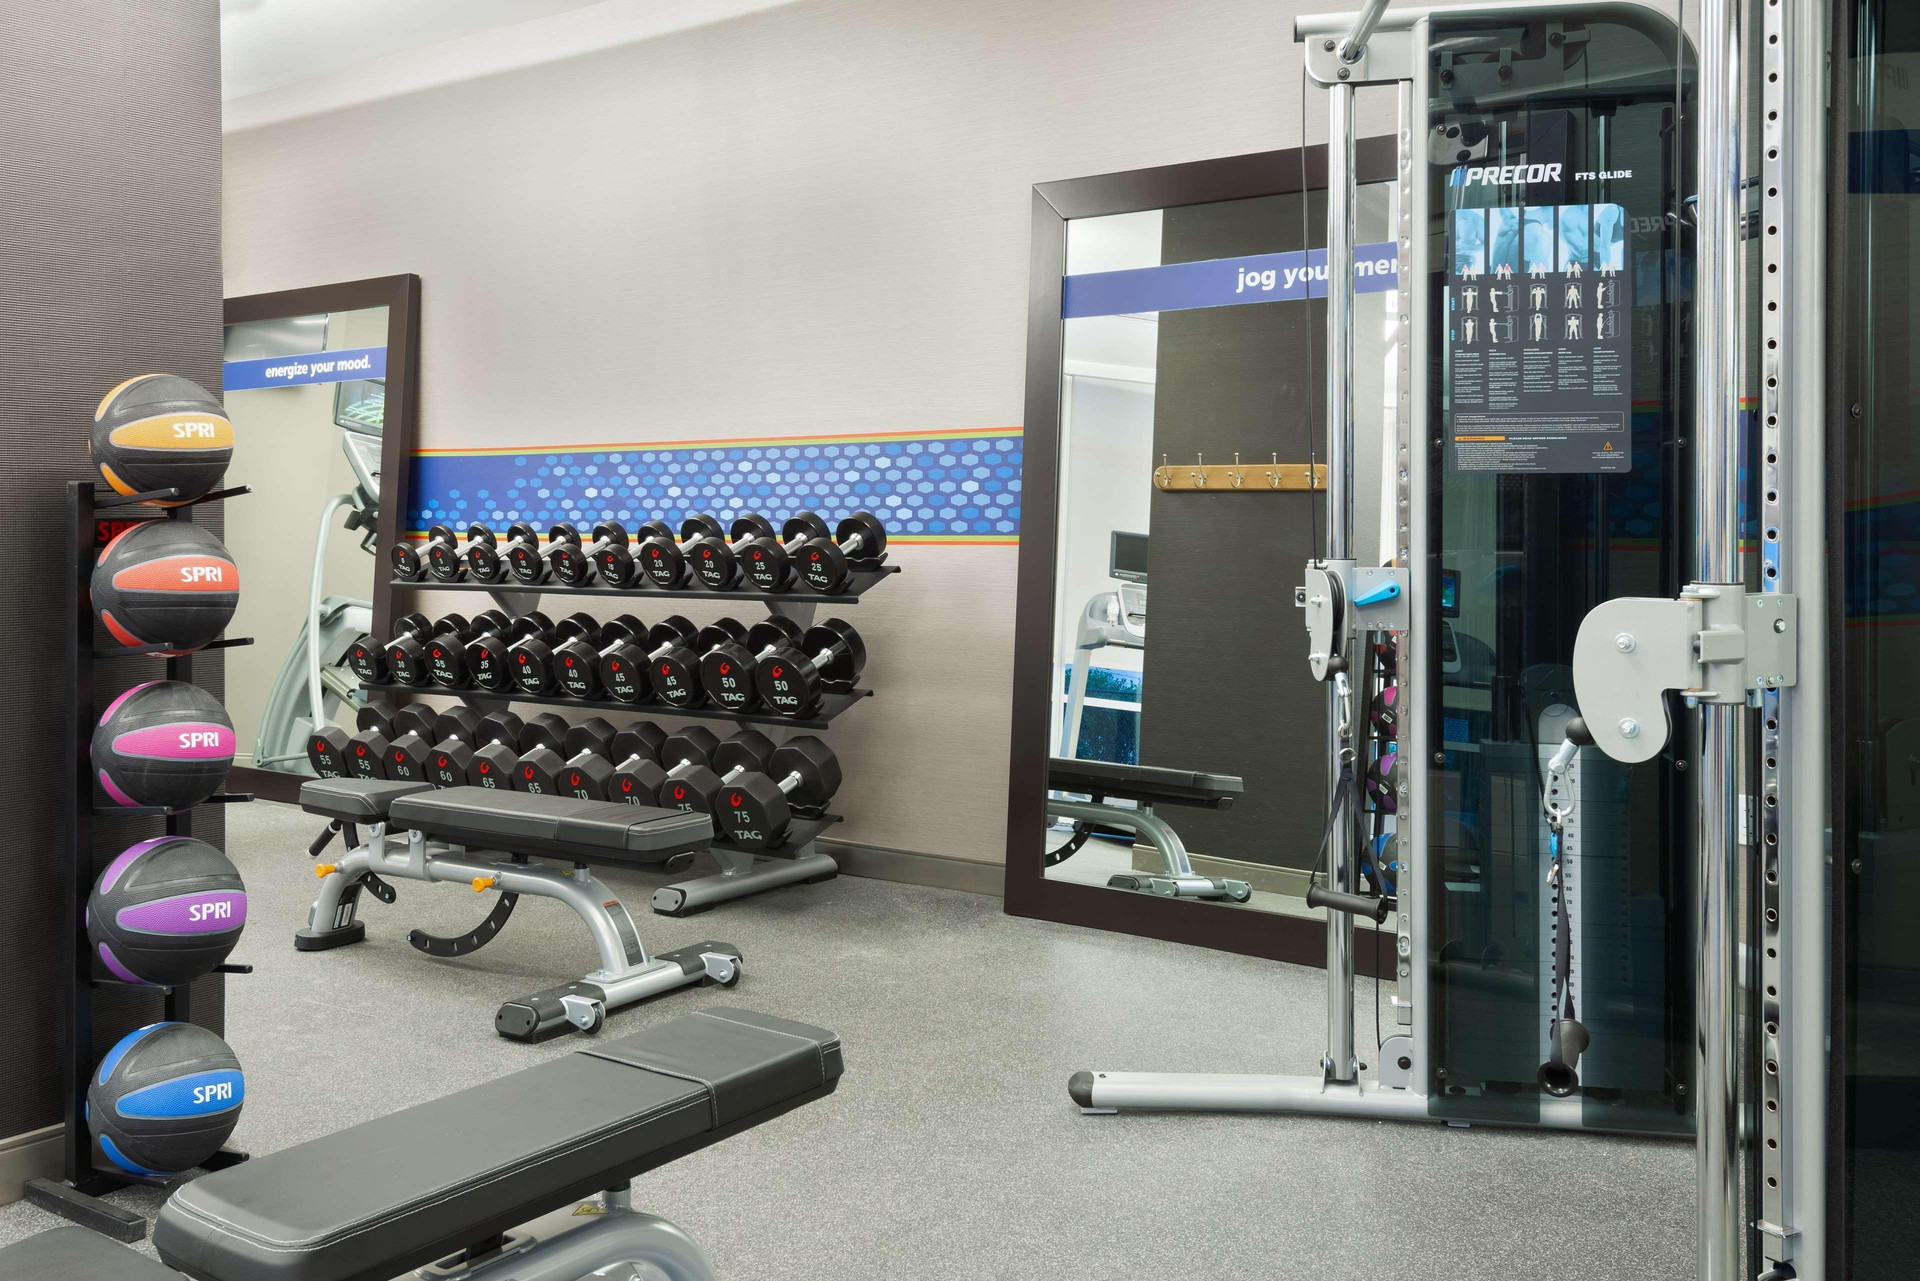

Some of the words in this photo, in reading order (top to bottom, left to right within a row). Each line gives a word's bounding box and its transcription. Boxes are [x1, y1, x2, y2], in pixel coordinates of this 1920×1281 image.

[1464, 162, 1562, 186] PRECOR
[1575, 172, 1596, 181] FTS
[1598, 170, 1632, 180] GLIDE
[1236, 268, 1276, 294] jog
[1284, 264, 1328, 289] you
[265, 362, 308, 380] energize
[310, 361, 334, 377] your
[337, 354, 371, 371] mood.
[172, 422, 215, 438] SPRI
[560, 566, 573, 575] TAG
[755, 562, 766, 570] 25
[811, 562, 822, 572] 25
[180, 566, 222, 582] SPRI
[604, 570, 619, 579] TAG
[702, 570, 720, 579] TAG
[808, 573, 828, 583] TAG
[481, 660, 489, 669] 35
[434, 669, 453, 679] TAG
[522, 666, 531, 674] 40
[569, 669, 578, 678] 40
[616, 673, 625, 682] 45
[666, 676, 677, 686] 45
[722, 677, 736, 688] 50
[774, 680, 788, 691] 50
[667, 688, 686, 698] TAG
[721, 693, 745, 702] TAG
[773, 696, 798, 705] TAG
[179, 731, 219, 748] SPRI
[320, 754, 332, 765] 55
[358, 759, 371, 771] 55
[397, 765, 410, 776] 60
[440, 770, 453, 782] 60
[482, 777, 496, 789] 65
[528, 783, 541, 793] 65
[574, 790, 588, 800] 70
[625, 796, 640, 806] 70
[678, 803, 693, 812] 75
[734, 811, 750, 823] 75
[734, 830, 762, 840] TAG
[189, 901, 231, 921] SPRI
[193, 1082, 232, 1104] SPRI
